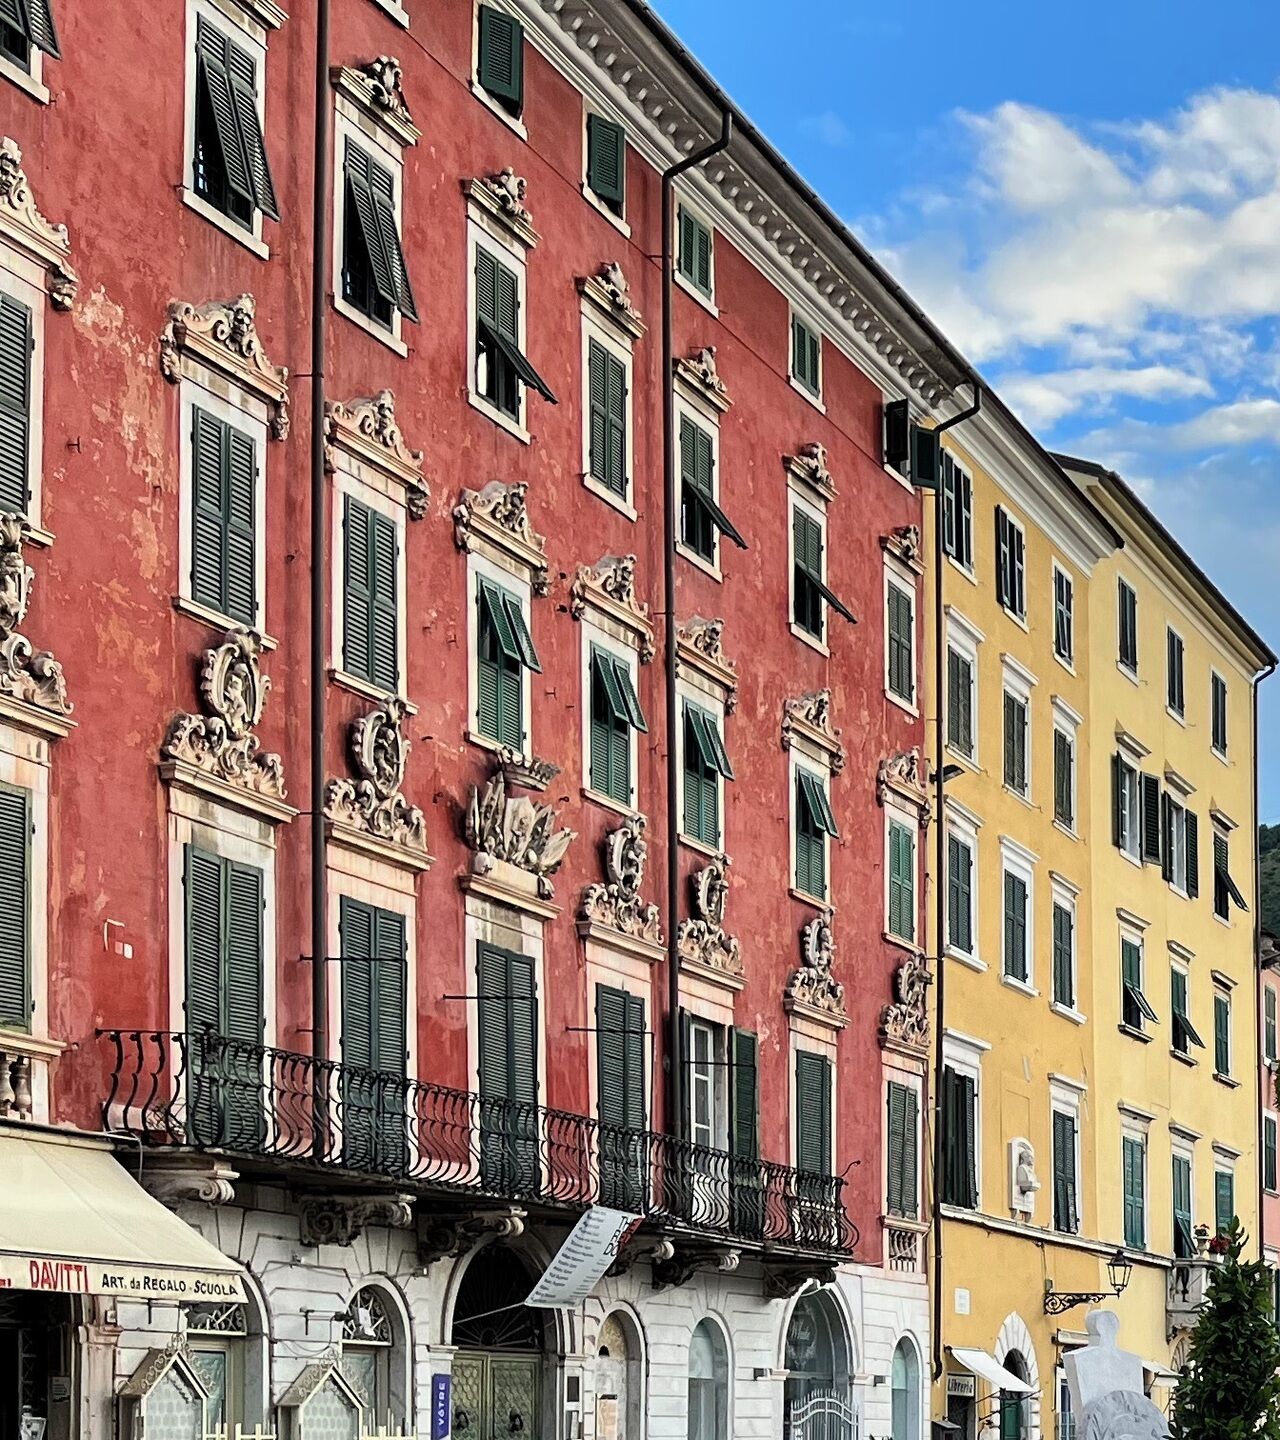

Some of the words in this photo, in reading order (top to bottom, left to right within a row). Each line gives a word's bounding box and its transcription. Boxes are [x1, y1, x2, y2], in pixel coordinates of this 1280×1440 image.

[29, 1260, 89, 1293] DAVITTI
[143, 1276, 186, 1292] REGALO
[194, 1280, 238, 1296] SCUOLA
